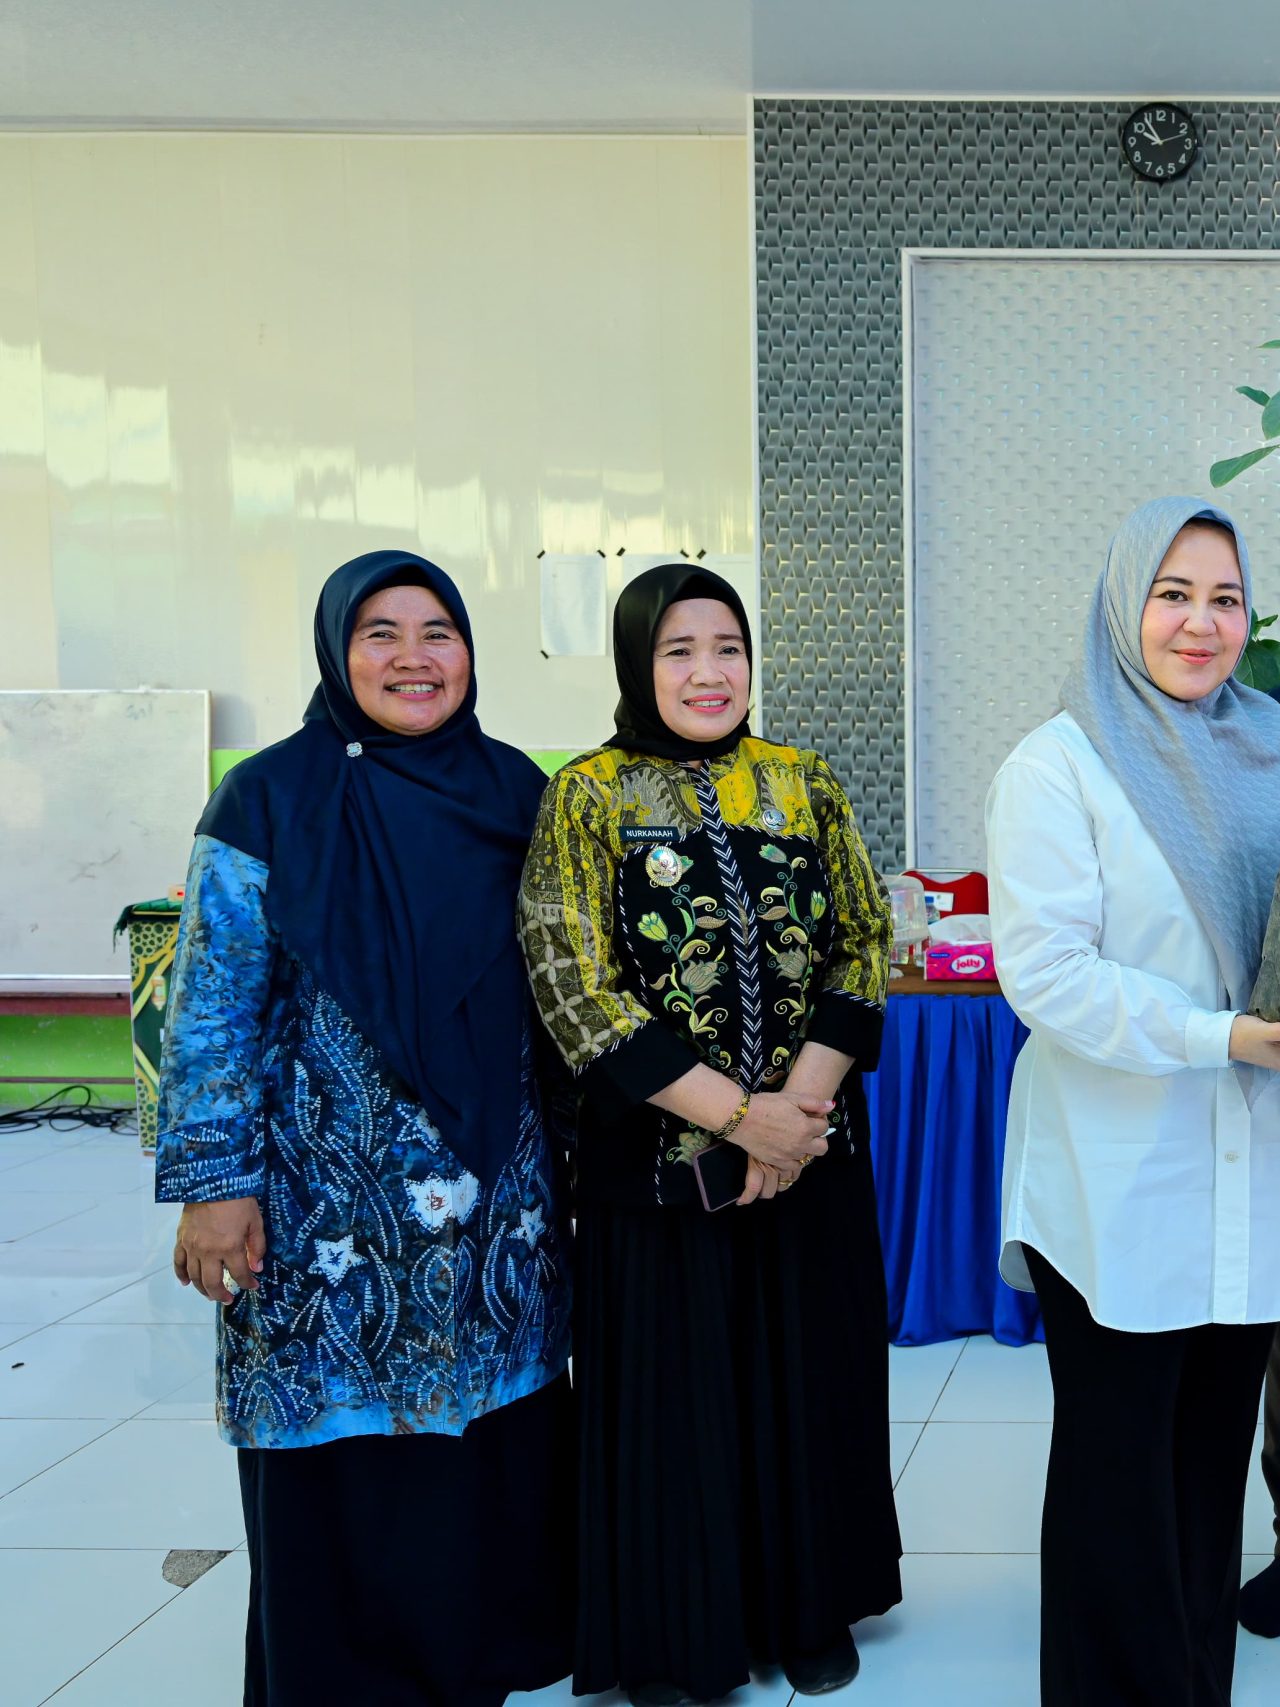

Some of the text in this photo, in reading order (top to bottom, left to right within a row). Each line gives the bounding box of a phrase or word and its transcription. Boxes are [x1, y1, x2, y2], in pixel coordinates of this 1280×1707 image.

[1144, 112, 1153, 124] 11
[1156, 110, 1166, 121] 12
[1171, 112, 1176, 124] 1
[1133, 122, 1145, 133] 10
[1179, 122, 1188, 134] 2
[1128, 136, 1137, 148] 9
[1184, 138, 1192, 150] 3
[1133, 151, 1141, 163] 8
[1178, 153, 1186, 164] 4
[1144, 161, 1153, 173] 7
[1155, 165, 1164, 176] 6
[1167, 163, 1176, 174] 5
